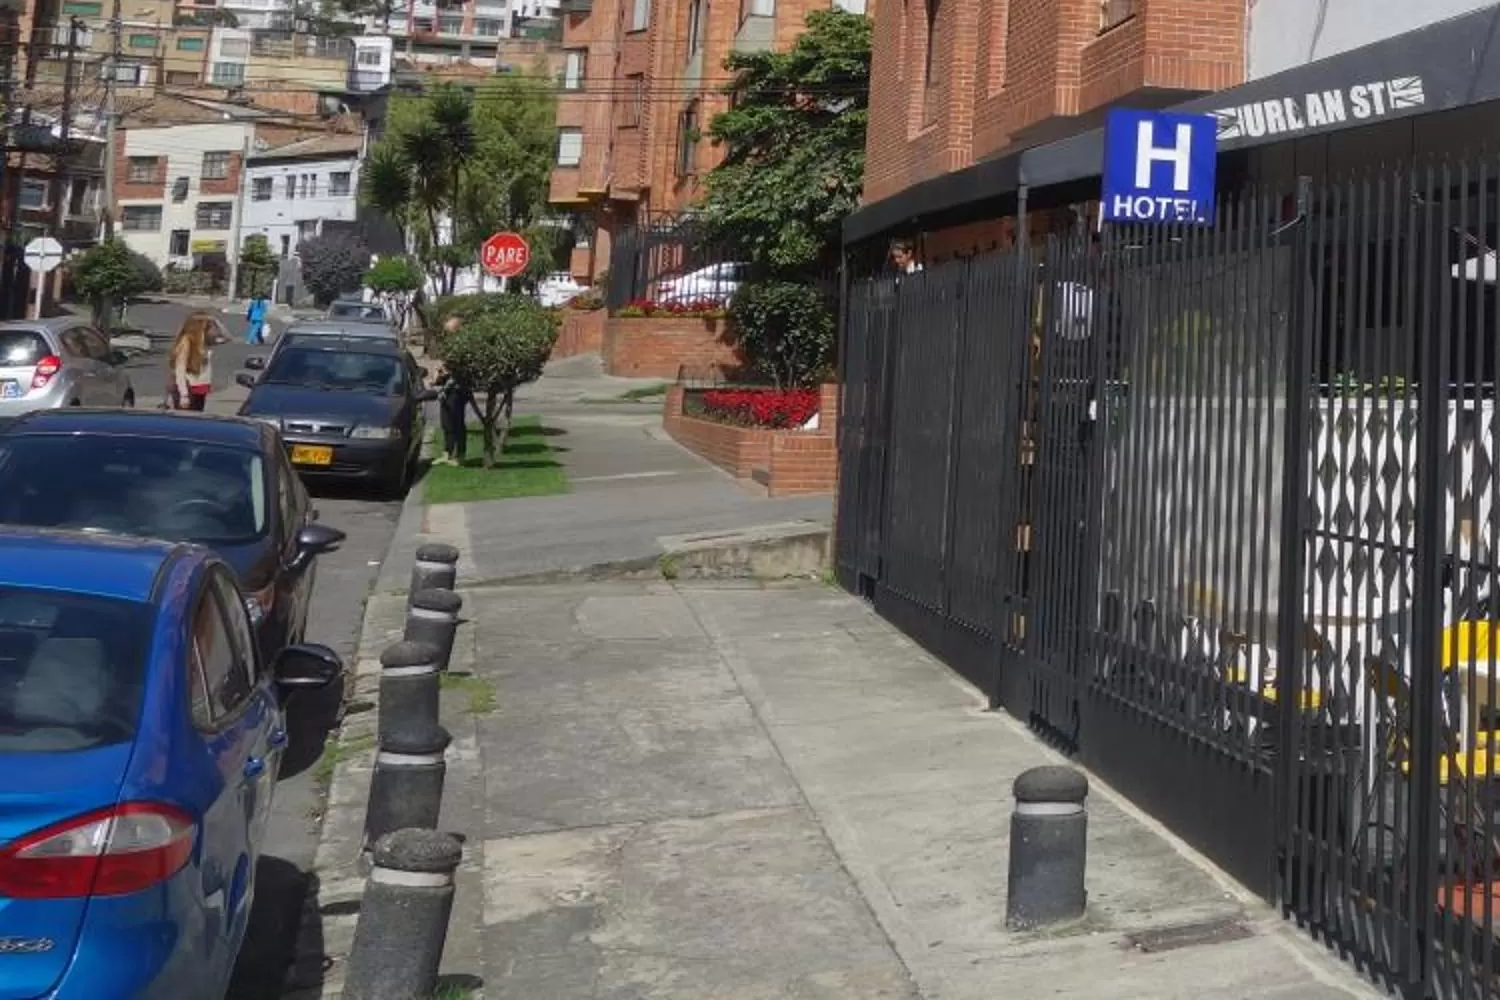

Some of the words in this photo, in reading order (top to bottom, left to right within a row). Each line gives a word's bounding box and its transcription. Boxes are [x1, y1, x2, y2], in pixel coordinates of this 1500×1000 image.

[1350, 81, 1386, 118] ST
[1135, 120, 1192, 191] H
[1113, 194, 1206, 222] HOTEL
[485, 245, 525, 264] PARE
